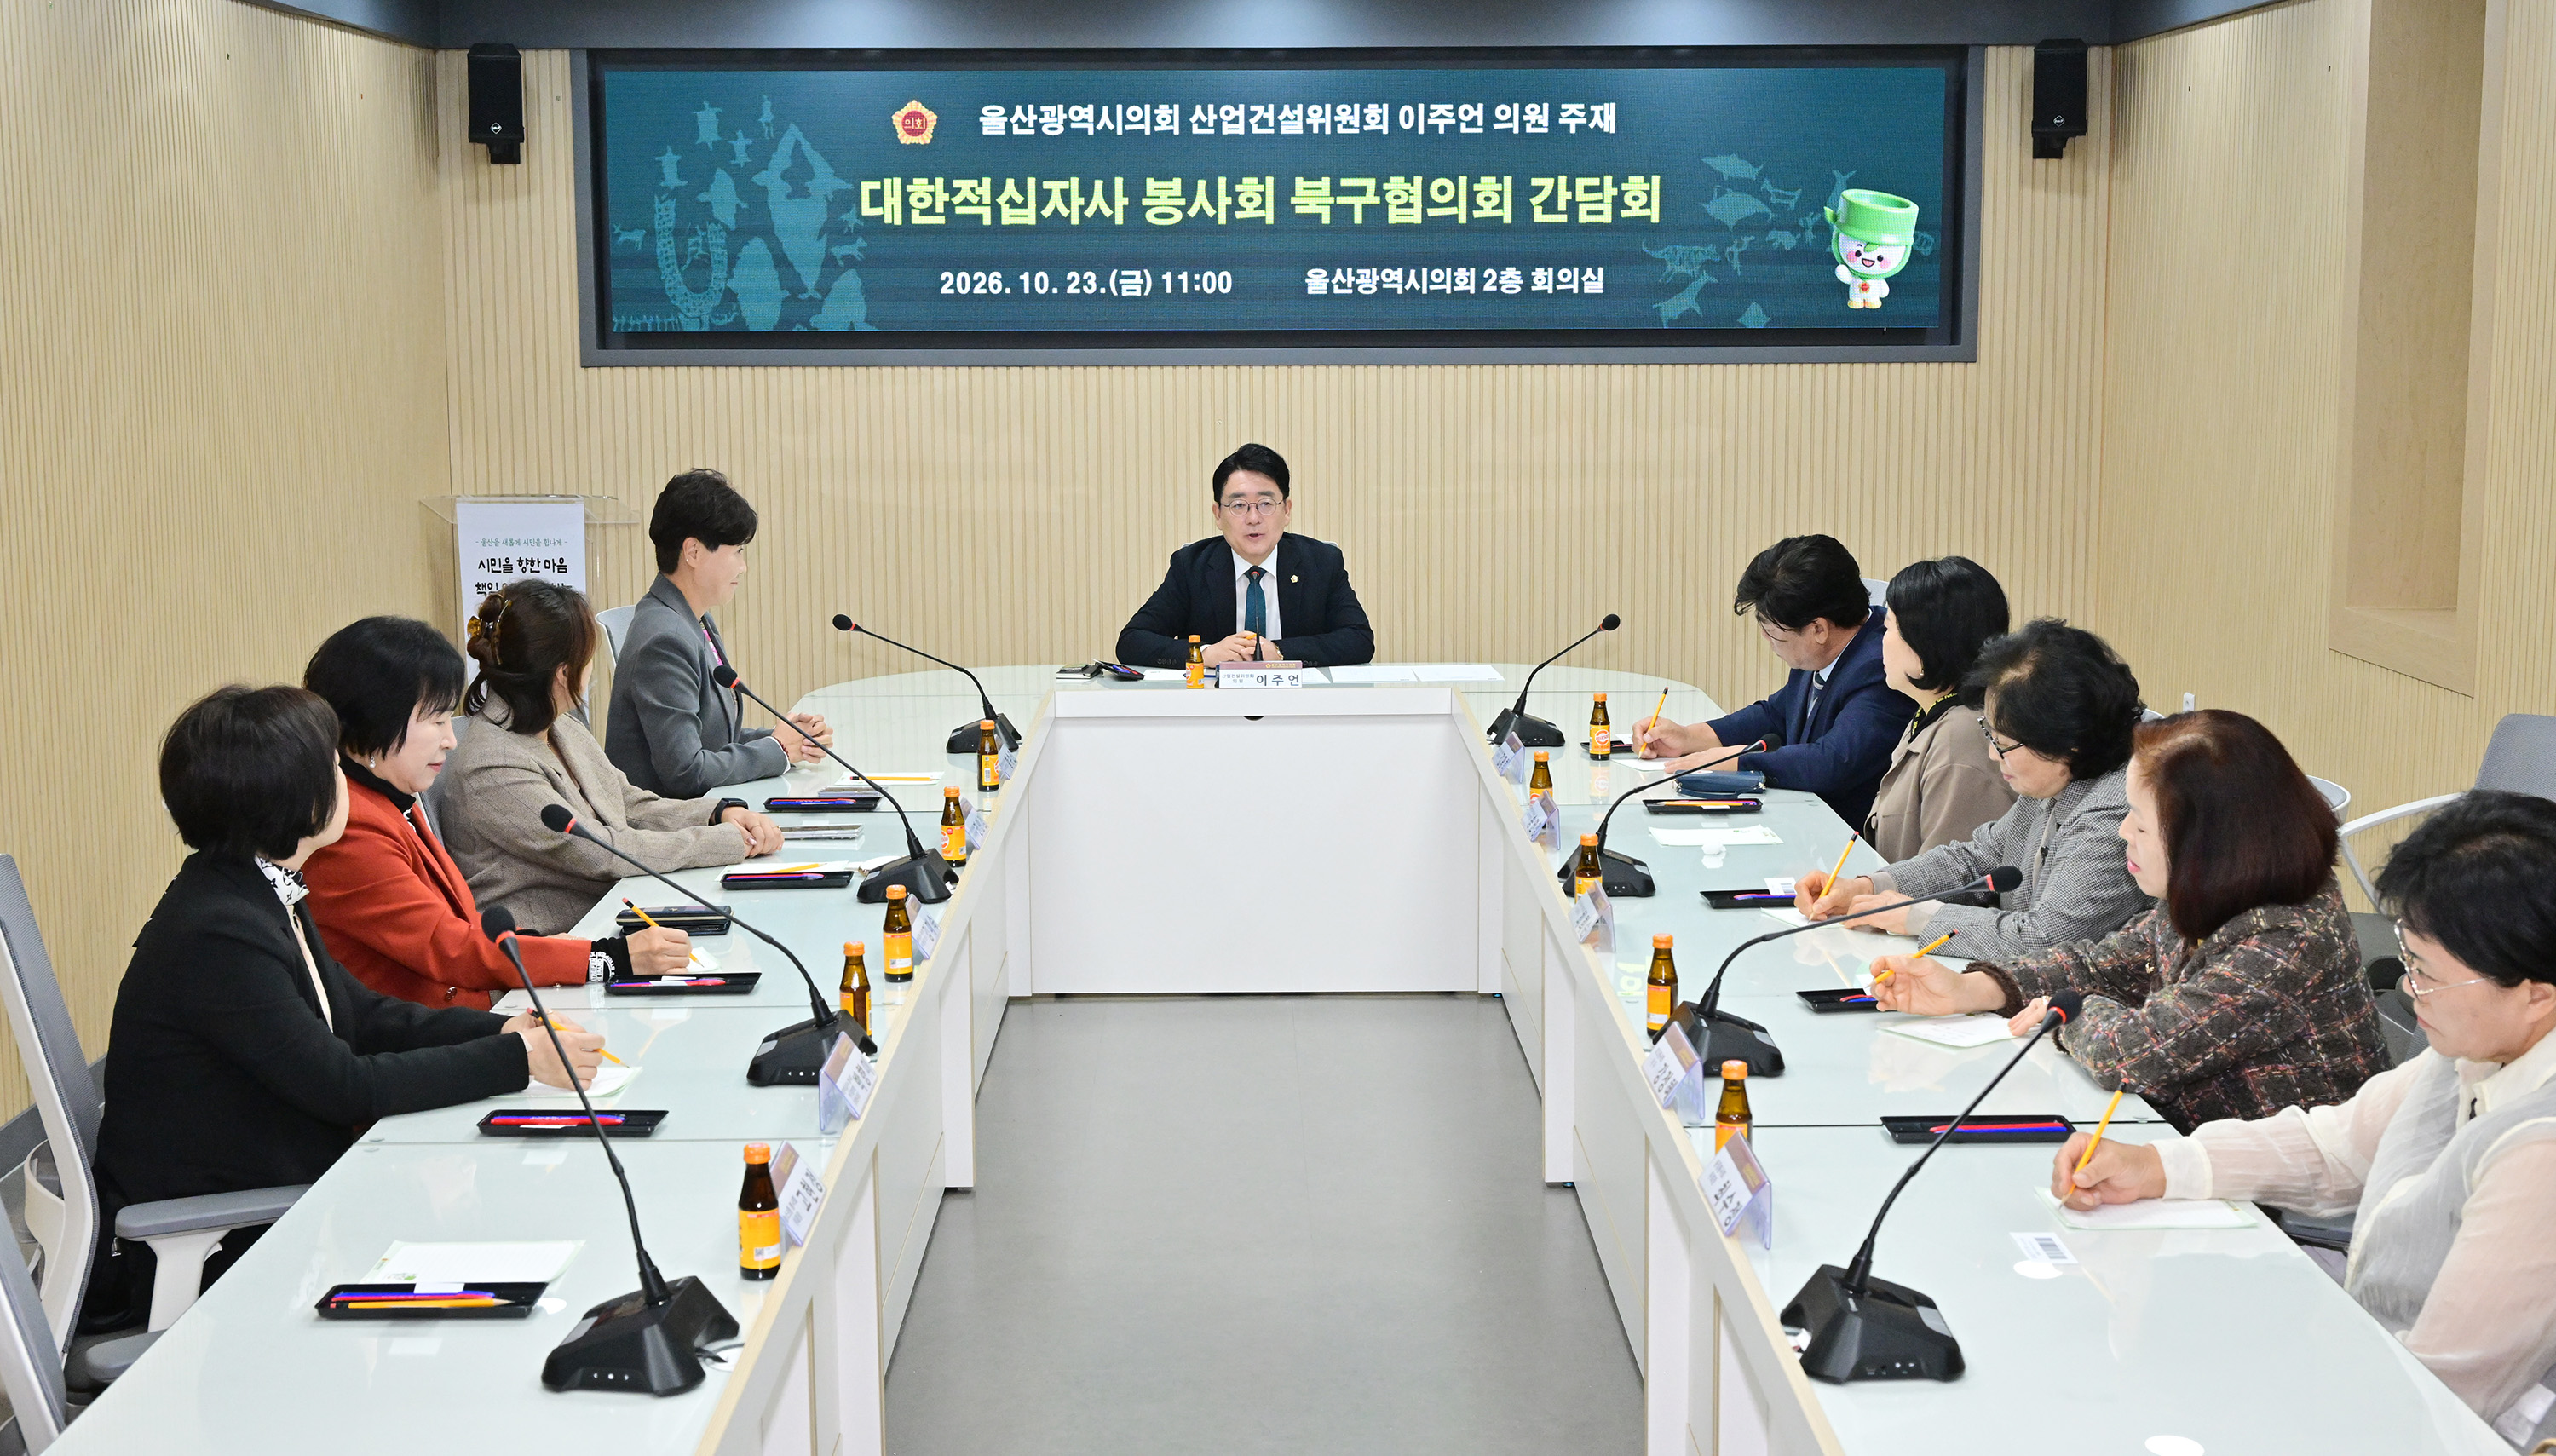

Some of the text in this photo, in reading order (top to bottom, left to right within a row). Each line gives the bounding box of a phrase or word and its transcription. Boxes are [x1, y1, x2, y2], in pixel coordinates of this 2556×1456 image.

[903, 118, 926, 129] 의회
[979, 102, 1616, 136] 울산광역시의회 산업건설위원회 이주언 의원 주재
[861, 175, 1661, 226] 대한적십자사 봉사회 북구협의회 간담회
[940, 268, 1233, 297] 2026. 10. 23.(금) 11:00
[1304, 267, 1604, 295] 울산광역시의회 2층 회의실
[522, 538, 542, 547] 시민을
[543, 538, 562, 547] 힘나게
[478, 556, 568, 574] 시민을 향한 마음
[1256, 674, 1299, 687] 이주언
